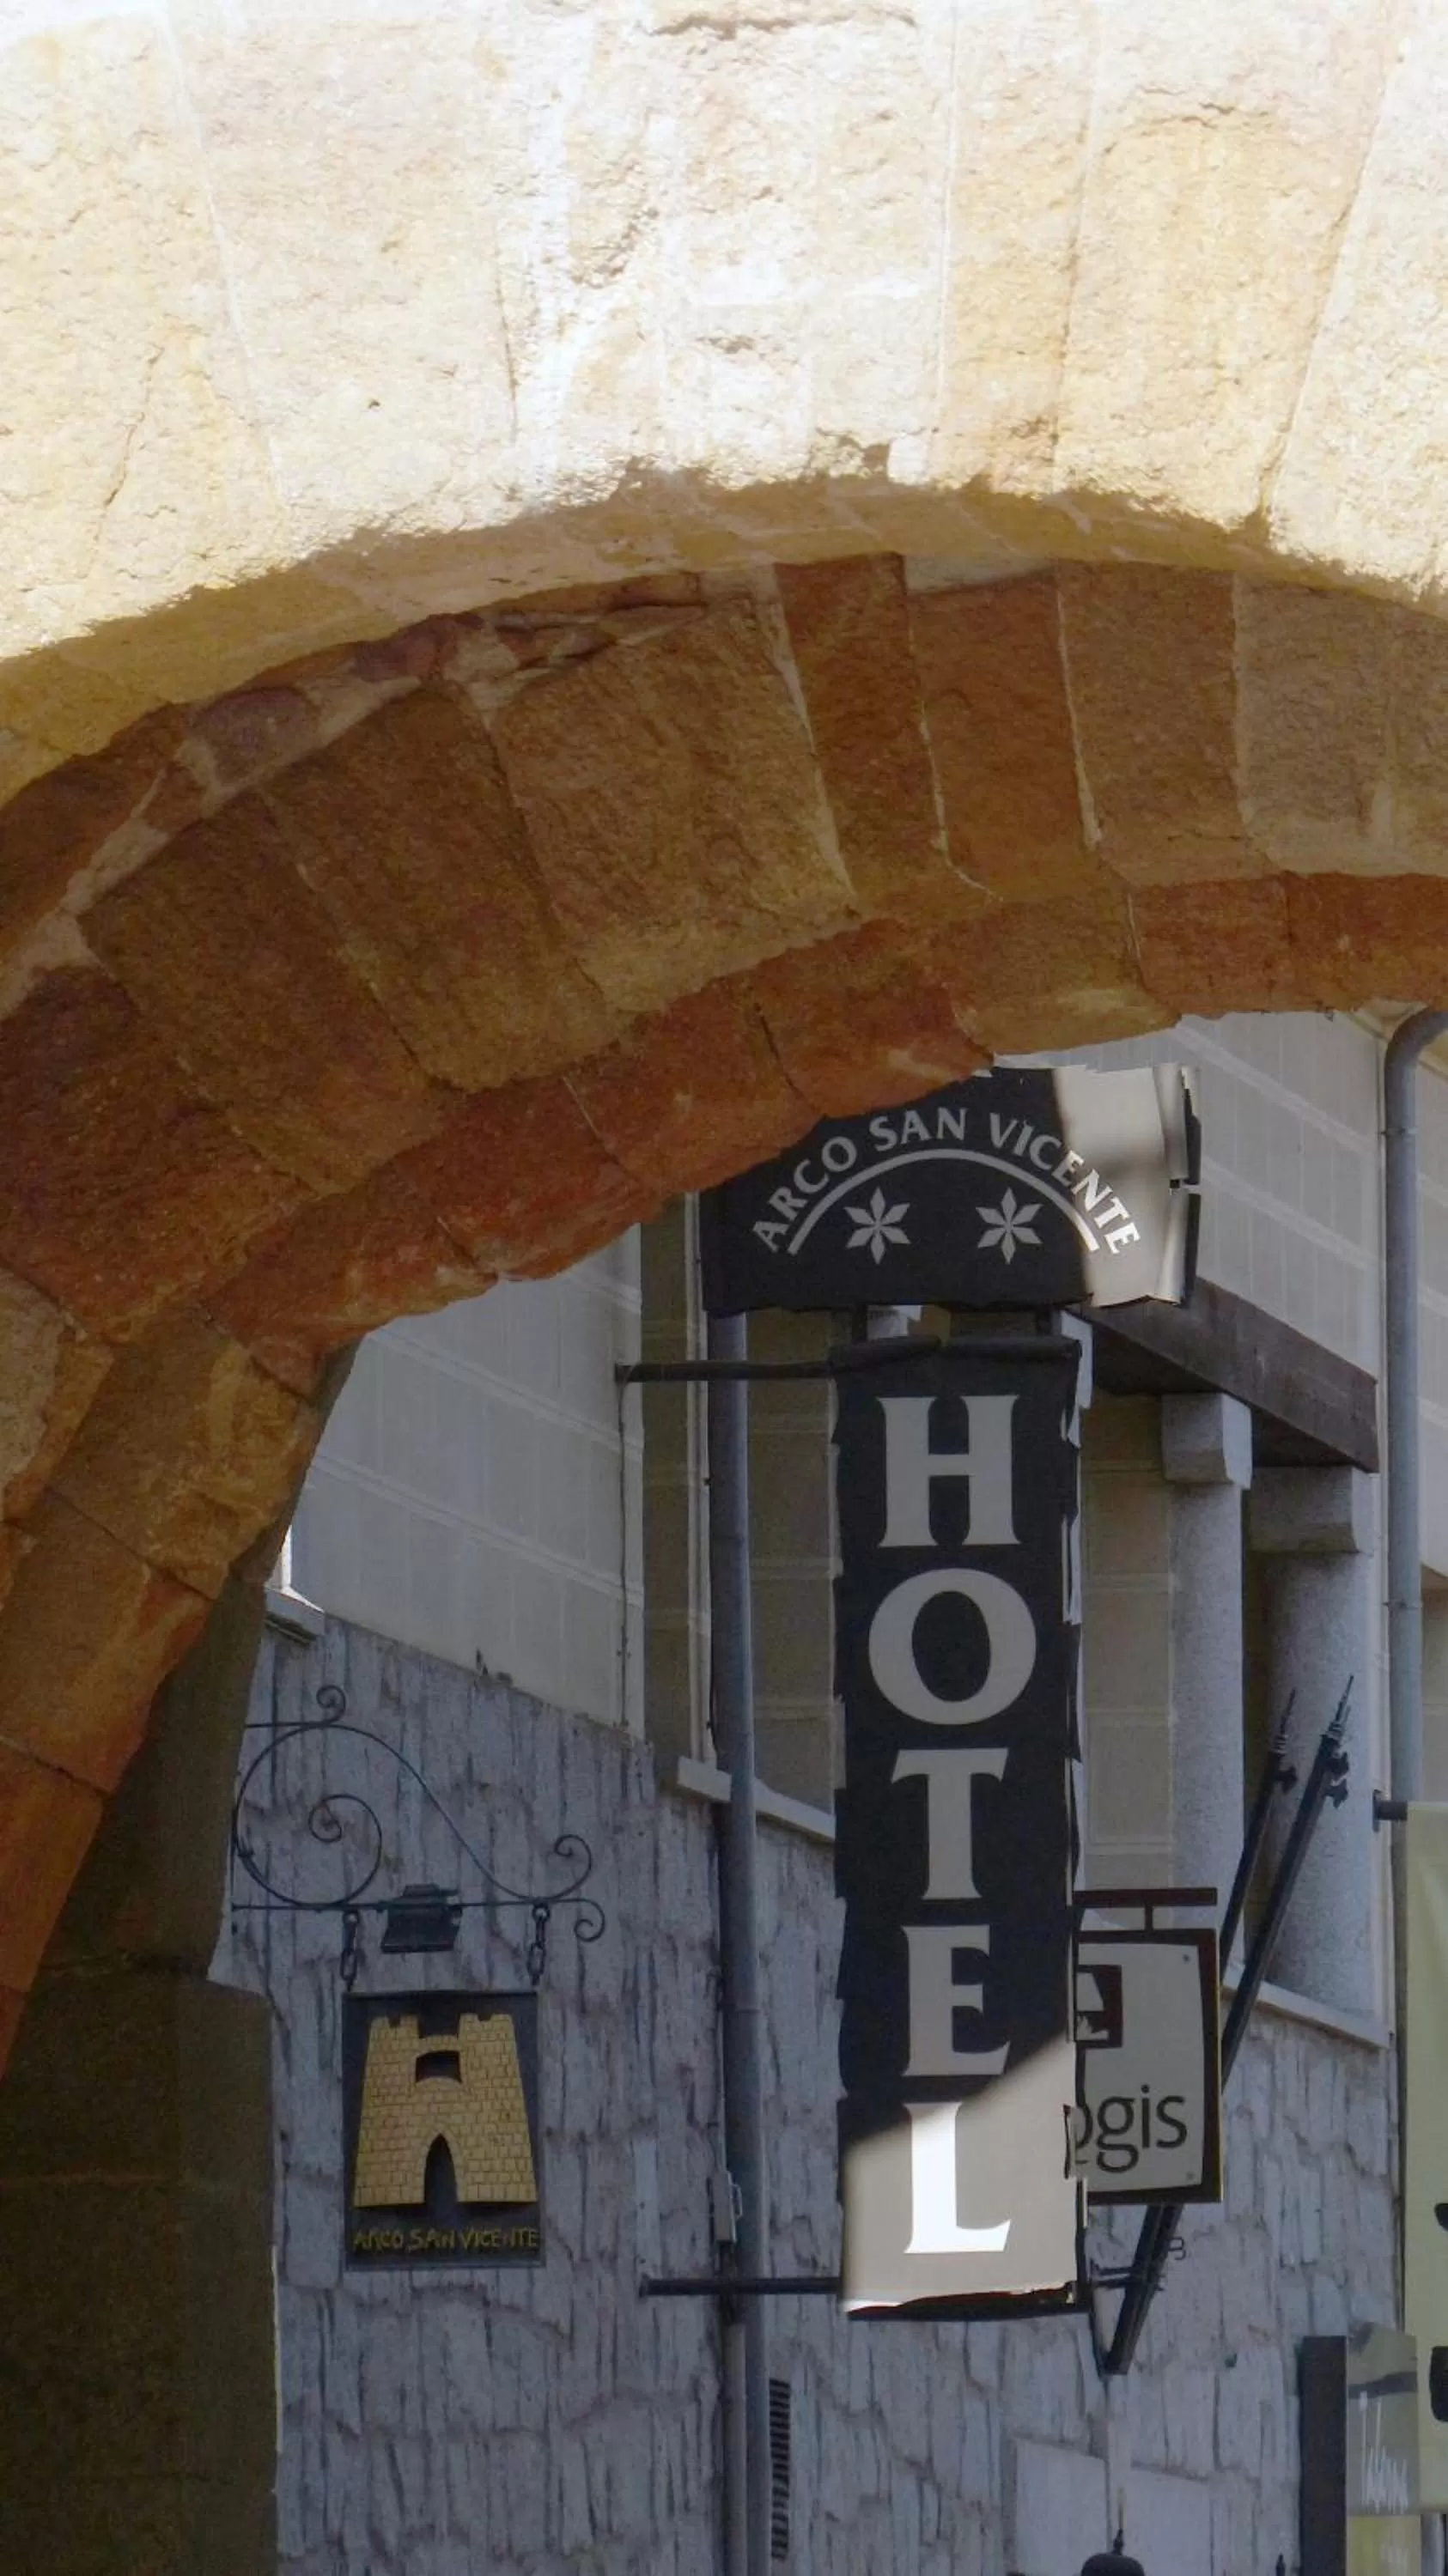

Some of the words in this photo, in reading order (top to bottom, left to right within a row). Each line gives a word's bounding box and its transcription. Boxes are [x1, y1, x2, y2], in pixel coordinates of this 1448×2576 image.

[751, 1134, 858, 1252] ARCO
[869, 1107, 967, 1152] SAN
[989, 1112, 1140, 1255] VICENTE
[868, 1394, 1037, 2254] HOTEL
[354, 2228, 405, 2252] ARCO
[408, 2228, 455, 2251] SAN
[461, 2227, 538, 2249] VICENTE
